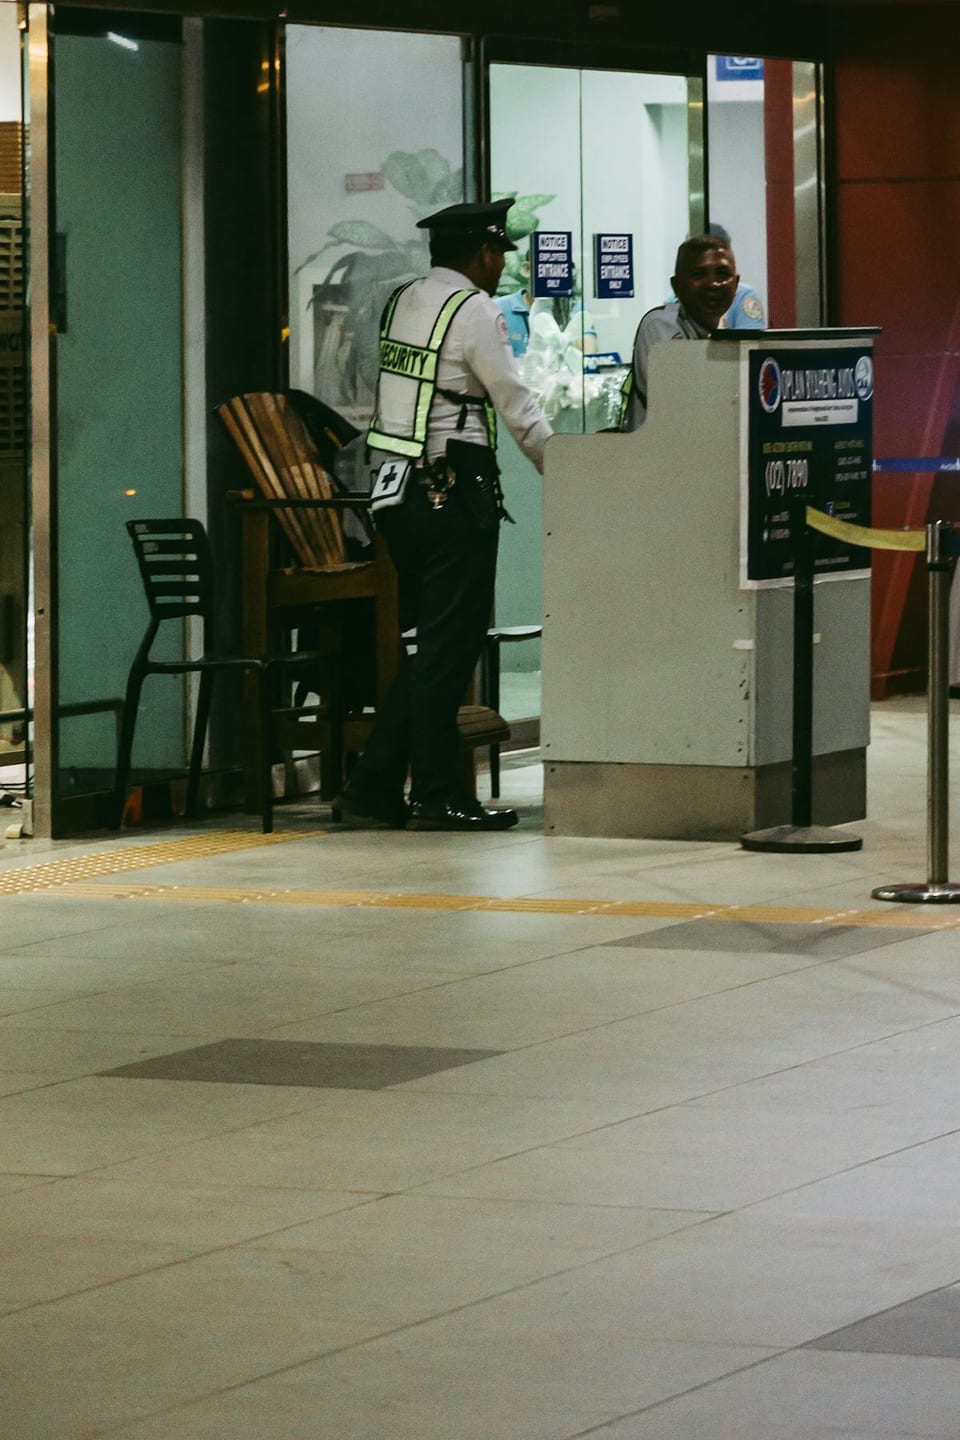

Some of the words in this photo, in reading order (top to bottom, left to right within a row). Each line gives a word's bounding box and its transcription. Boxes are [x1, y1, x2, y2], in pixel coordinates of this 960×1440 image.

[541, 236, 566, 248] NOTICE
[603, 238, 627, 250] NOTICE
[538, 252, 568, 262] EMPLOYEES
[601, 254, 629, 263] EMPLOYEES
[538, 263, 569, 278] ENTRANCE
[600, 265, 630, 279] ENTRANCE
[546, 279, 560, 288] ONLY
[609, 280, 622, 289] ONLY
[765, 461, 785, 496] (02)
[786, 459, 809, 488] 7890
